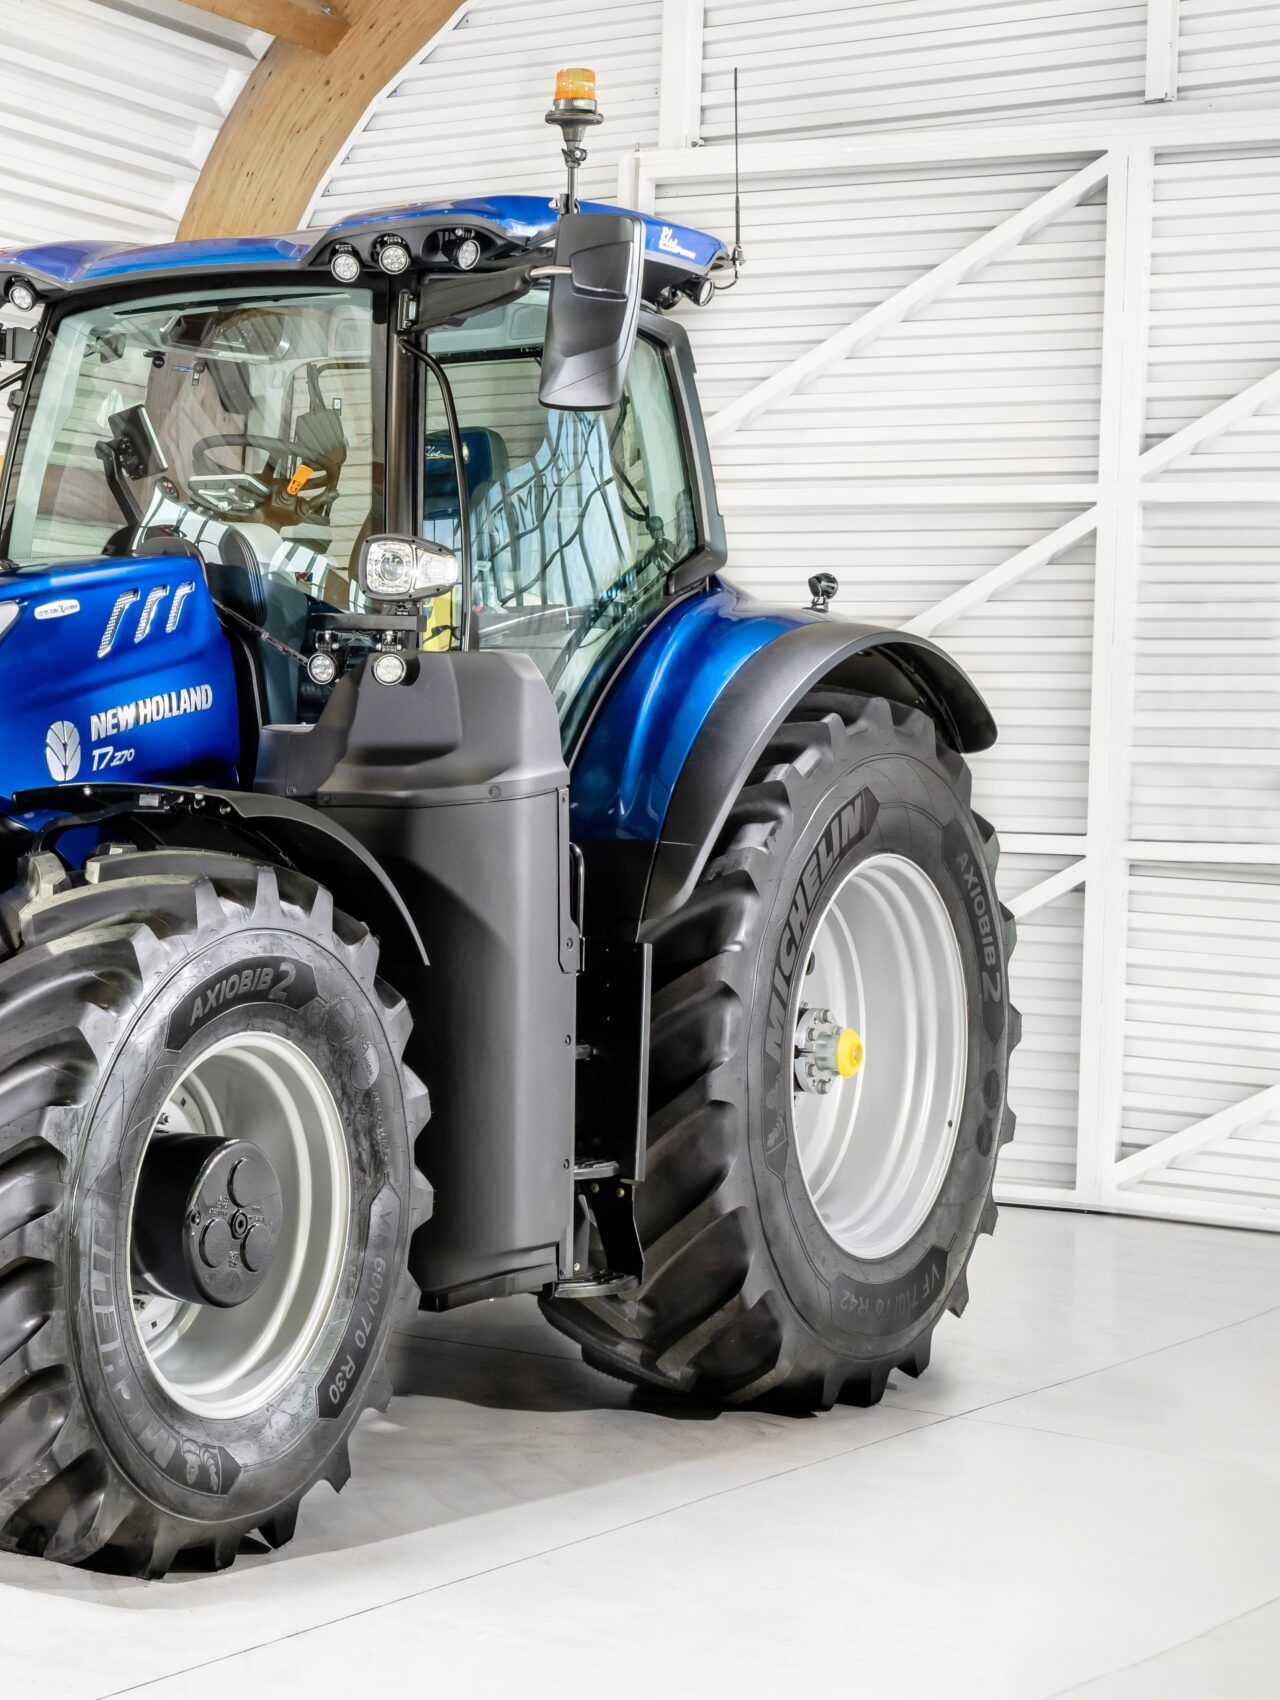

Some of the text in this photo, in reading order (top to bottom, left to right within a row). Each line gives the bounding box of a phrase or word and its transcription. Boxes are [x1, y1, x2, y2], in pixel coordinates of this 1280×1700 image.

[90, 684, 212, 742] NEW HOLLAND
[765, 797, 864, 1063] MICHELIN
[956, 850, 1002, 1002] AXIOBIB 2
[190, 961, 297, 1027] AXIOBIB 2
[354, 1257, 387, 1349] 600/70
[840, 1290, 870, 1317] R42
[328, 1354, 356, 1405] R30
